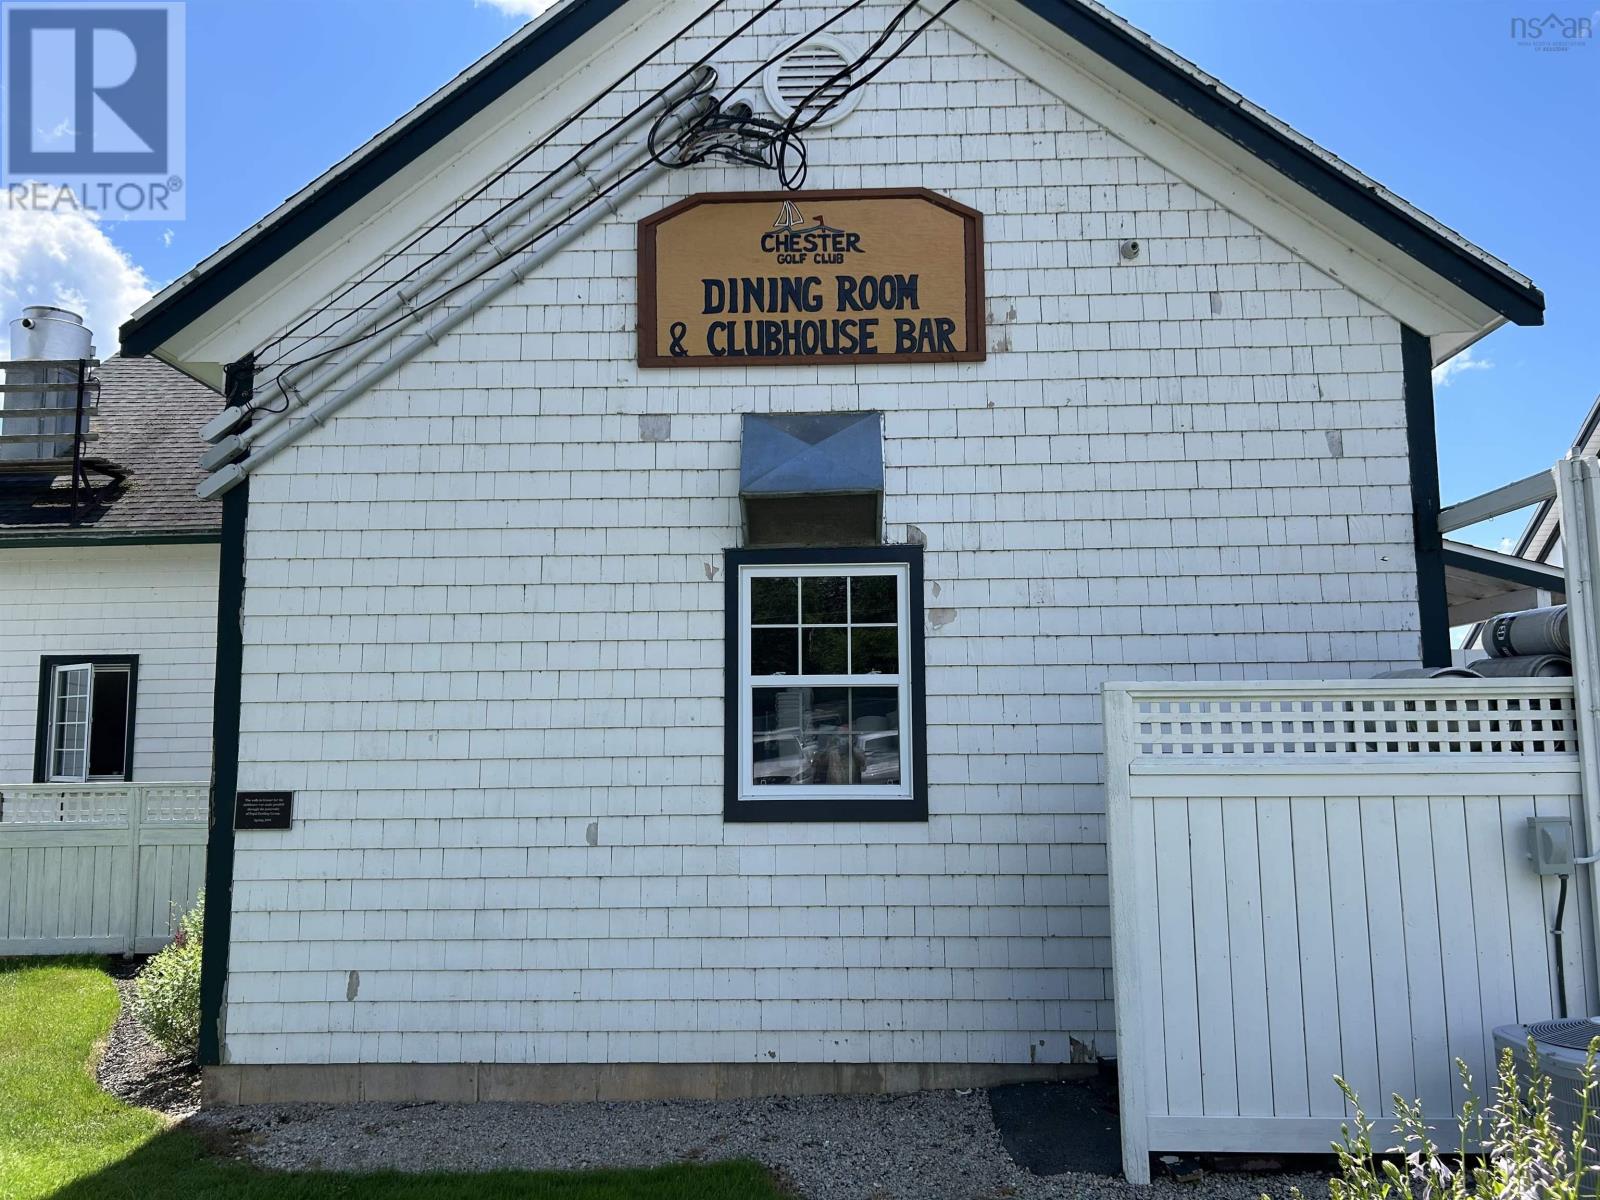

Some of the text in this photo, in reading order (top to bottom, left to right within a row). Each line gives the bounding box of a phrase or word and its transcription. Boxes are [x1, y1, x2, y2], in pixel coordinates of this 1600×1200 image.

[761, 232, 865, 253] CHESTER
[777, 253, 844, 265] GOLF CLUB
[702, 274, 920, 314] DINING ROOM
[669, 317, 957, 357] & CLUBHOUSE BAR
